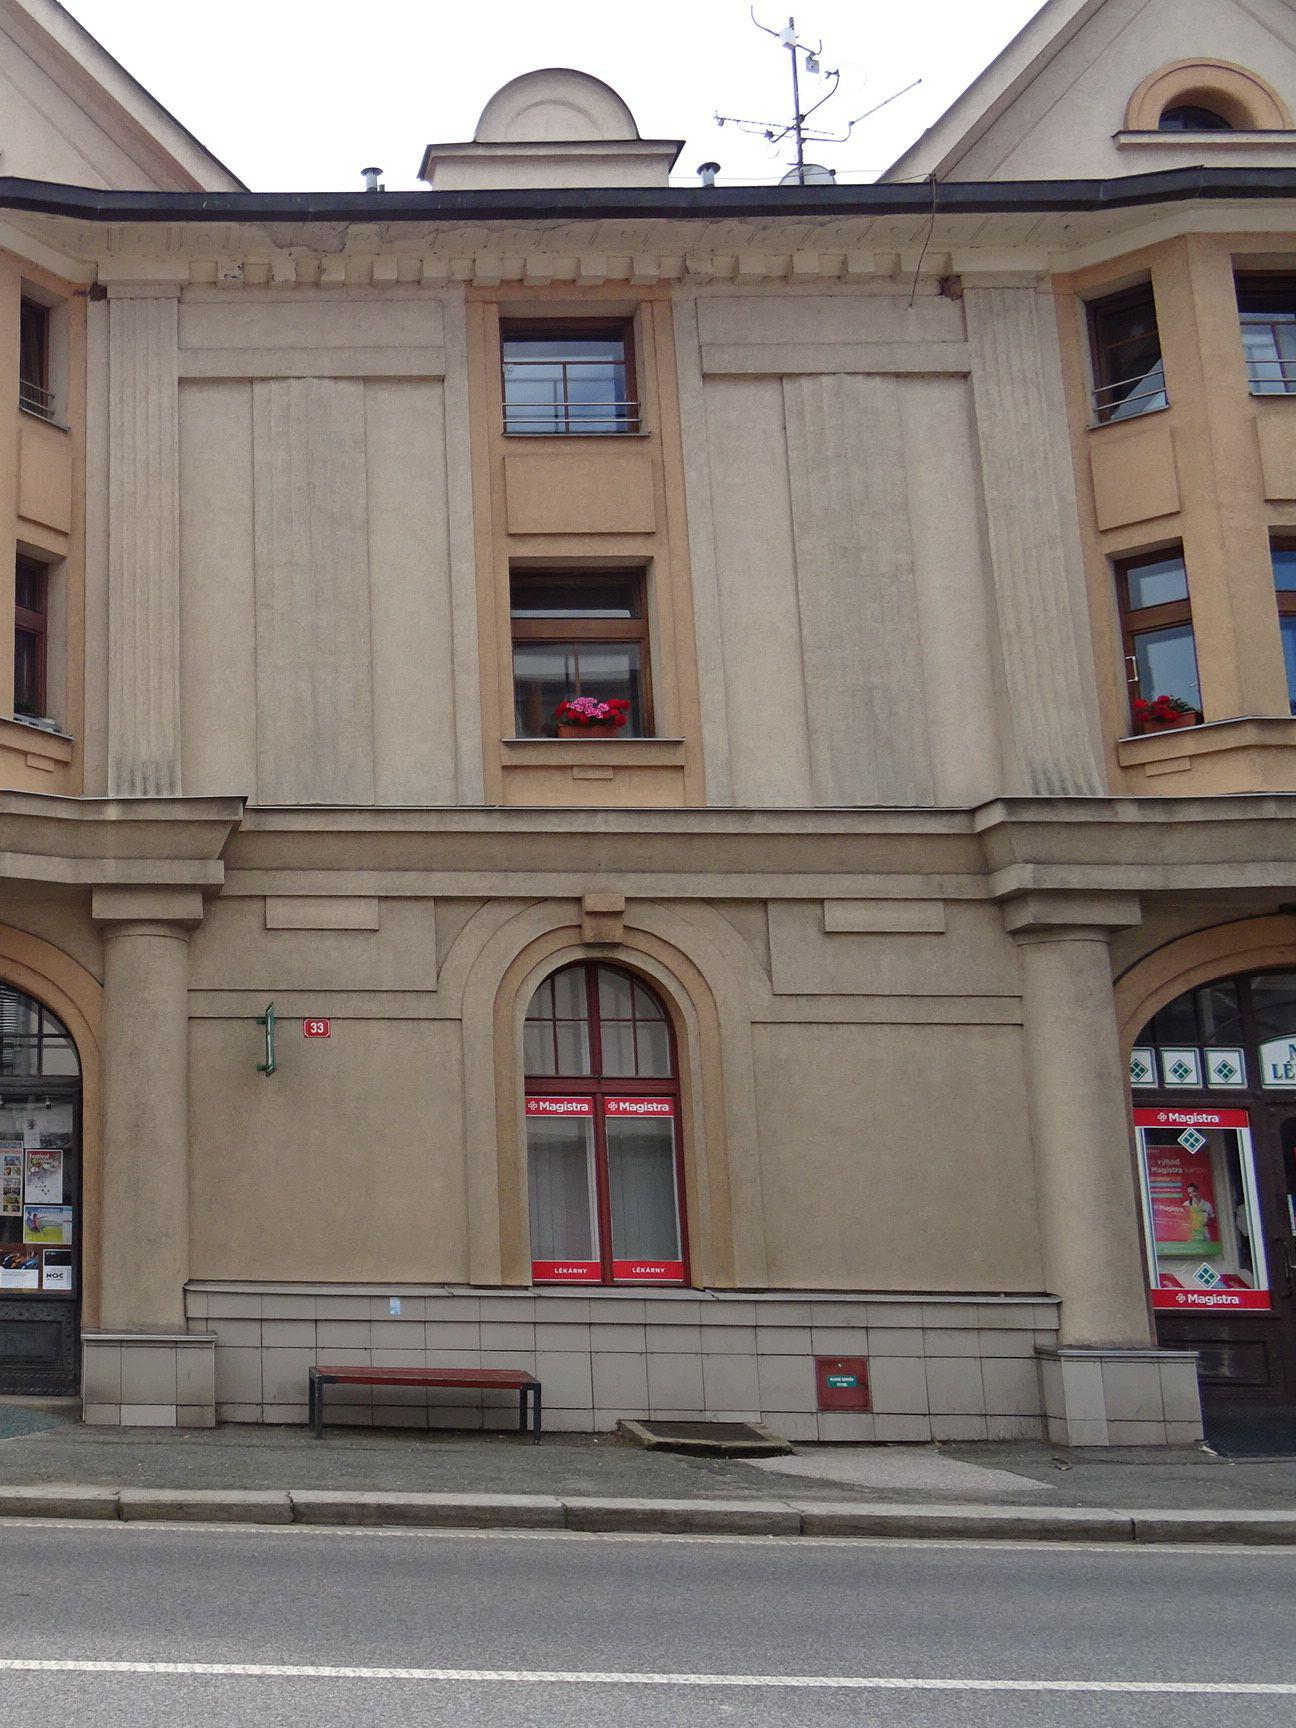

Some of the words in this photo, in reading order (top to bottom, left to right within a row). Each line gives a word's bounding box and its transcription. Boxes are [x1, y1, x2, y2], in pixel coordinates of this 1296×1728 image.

[310, 1022, 324, 1033] 33
[1271, 1061, 1296, 1080] LÉ
[539, 1101, 589, 1113] Magistra
[619, 1102, 669, 1113] Magistra
[1168, 1112, 1220, 1124] Magistra
[1151, 1166, 1183, 1175] Magistra
[1188, 1293, 1240, 1306] Magistra
